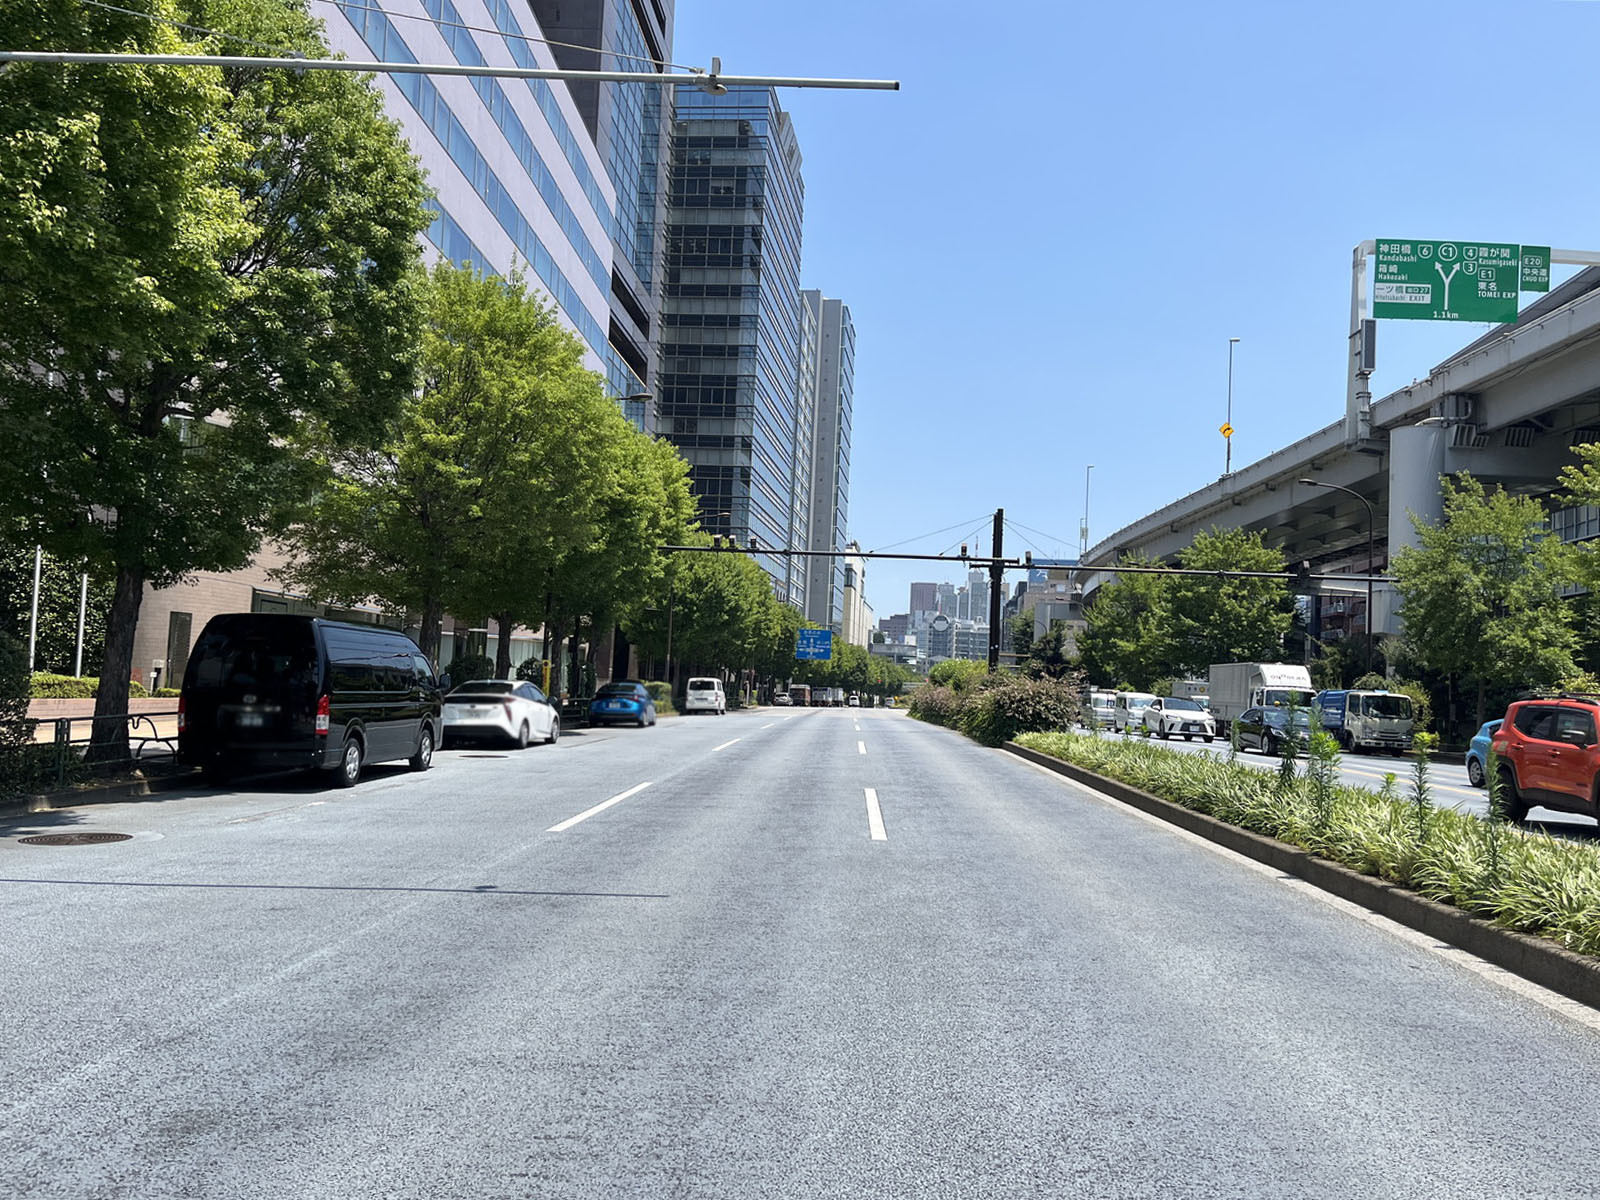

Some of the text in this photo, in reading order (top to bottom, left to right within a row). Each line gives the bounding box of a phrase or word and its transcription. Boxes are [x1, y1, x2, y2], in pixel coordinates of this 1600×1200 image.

[1441, 247, 1453, 257] C1
[1480, 270, 1493, 278] E1
[1433, 311, 1459, 319] 1.1km
